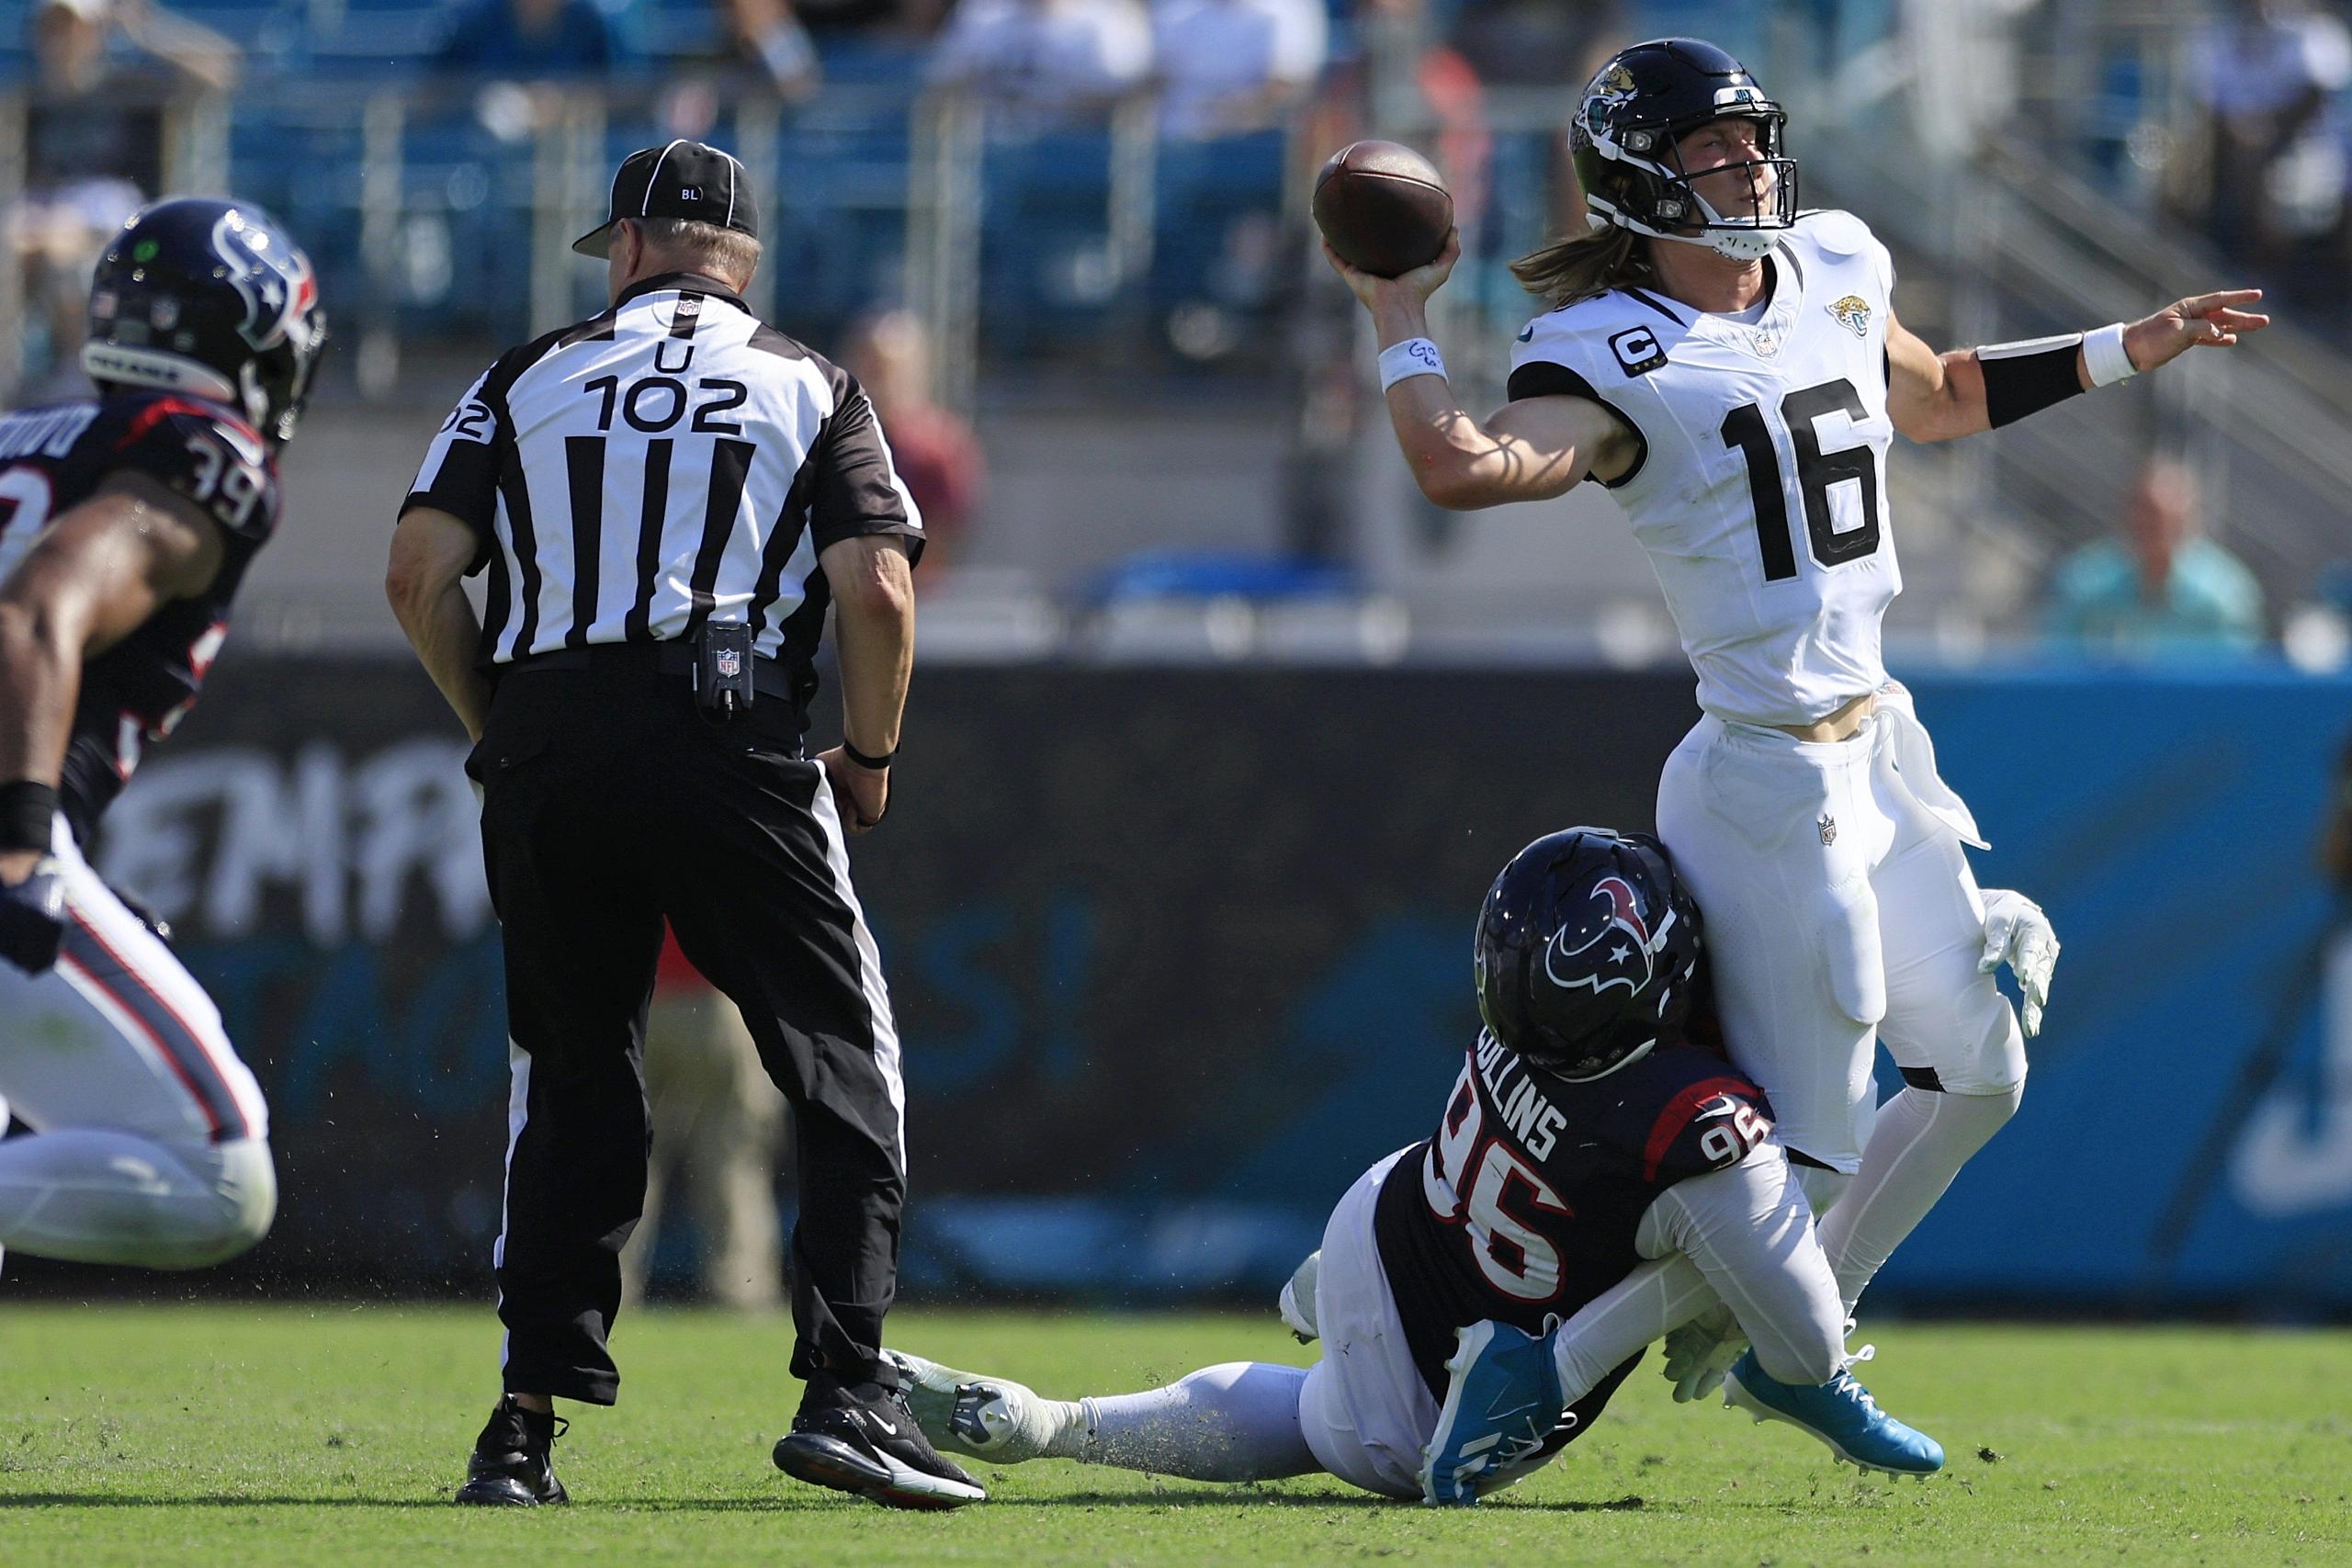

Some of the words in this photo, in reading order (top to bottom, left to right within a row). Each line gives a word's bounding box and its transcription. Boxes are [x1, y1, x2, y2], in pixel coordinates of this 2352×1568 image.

[681, 189, 699, 200] BL
[654, 341, 695, 374] U
[1614, 330, 1658, 366] C
[584, 375, 748, 434] 102
[1719, 377, 1882, 582] 16
[1700, 1105, 1771, 1171] 96
[1421, 1044, 1569, 1301] 96
